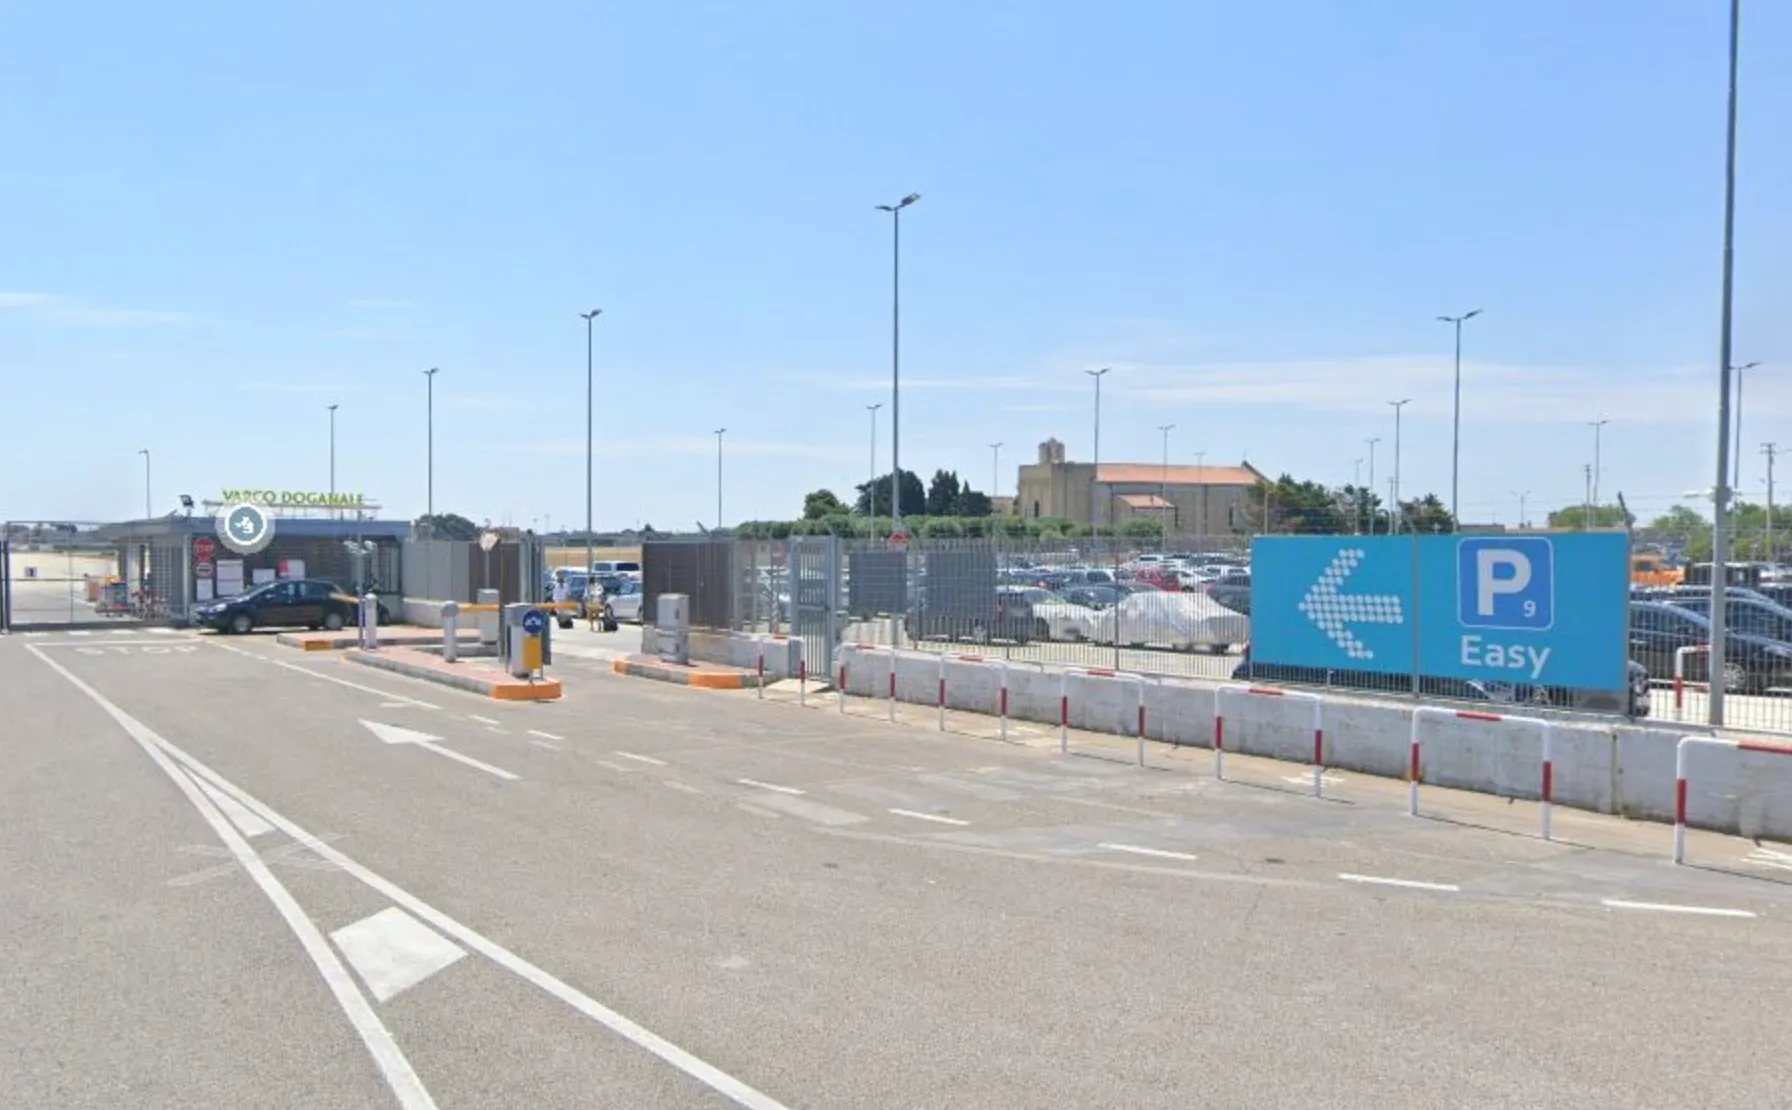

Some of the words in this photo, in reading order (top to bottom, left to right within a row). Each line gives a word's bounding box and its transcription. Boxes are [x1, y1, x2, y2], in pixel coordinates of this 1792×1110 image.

[222, 489, 276, 503] VARCO
[282, 490, 364, 505] DOGANALE
[1476, 548, 1532, 616] P
[1523, 600, 1537, 618] 9
[74, 645, 198, 656] STOP
[1460, 634, 1552, 680] Easy
